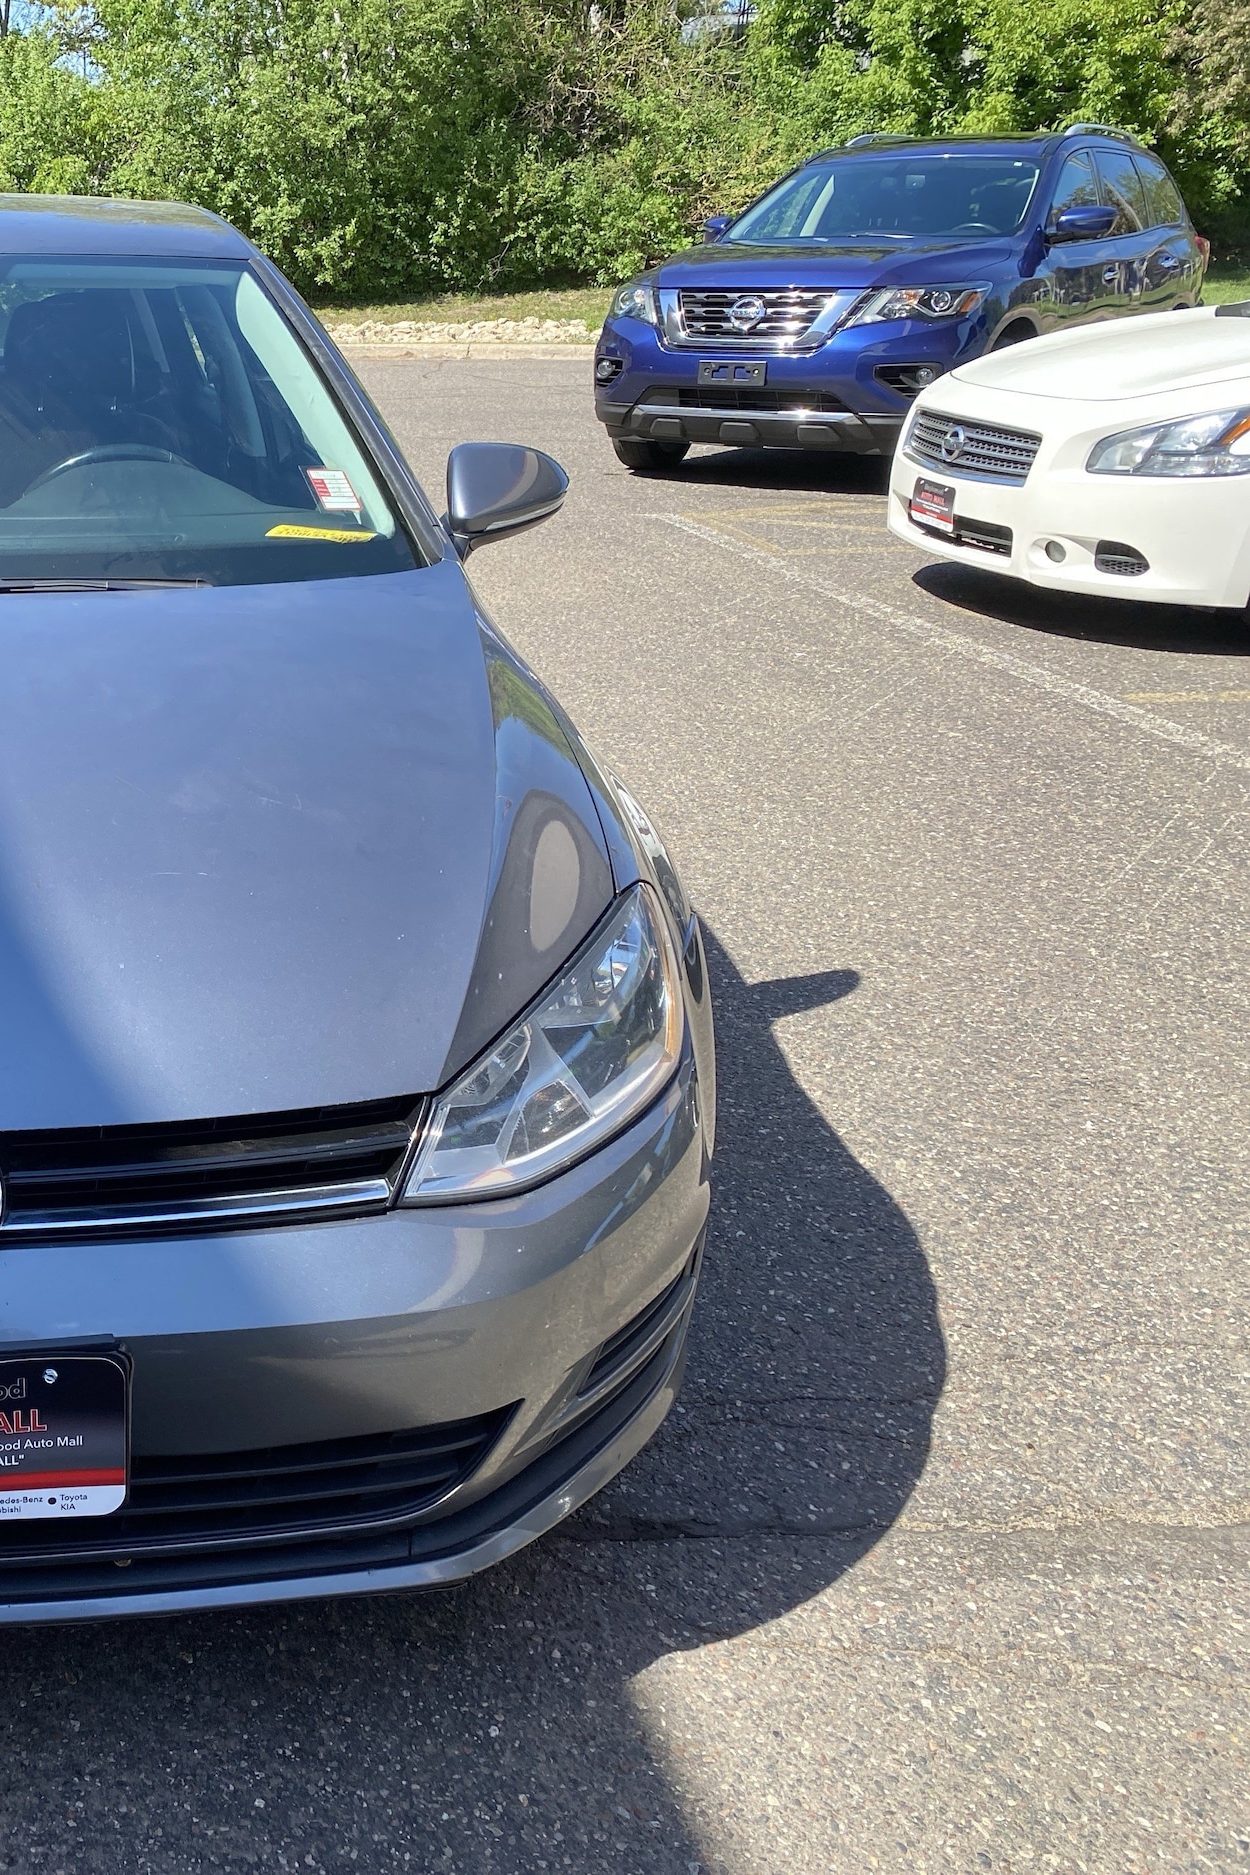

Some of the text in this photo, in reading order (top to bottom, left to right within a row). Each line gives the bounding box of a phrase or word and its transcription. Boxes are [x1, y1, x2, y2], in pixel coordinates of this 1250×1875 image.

[24, 1438, 54, 1449] Auto
[57, 1435, 83, 1447] Mall
[59, 1493, 88, 1502] Toyota
[60, 1503, 76, 1511] KIA
